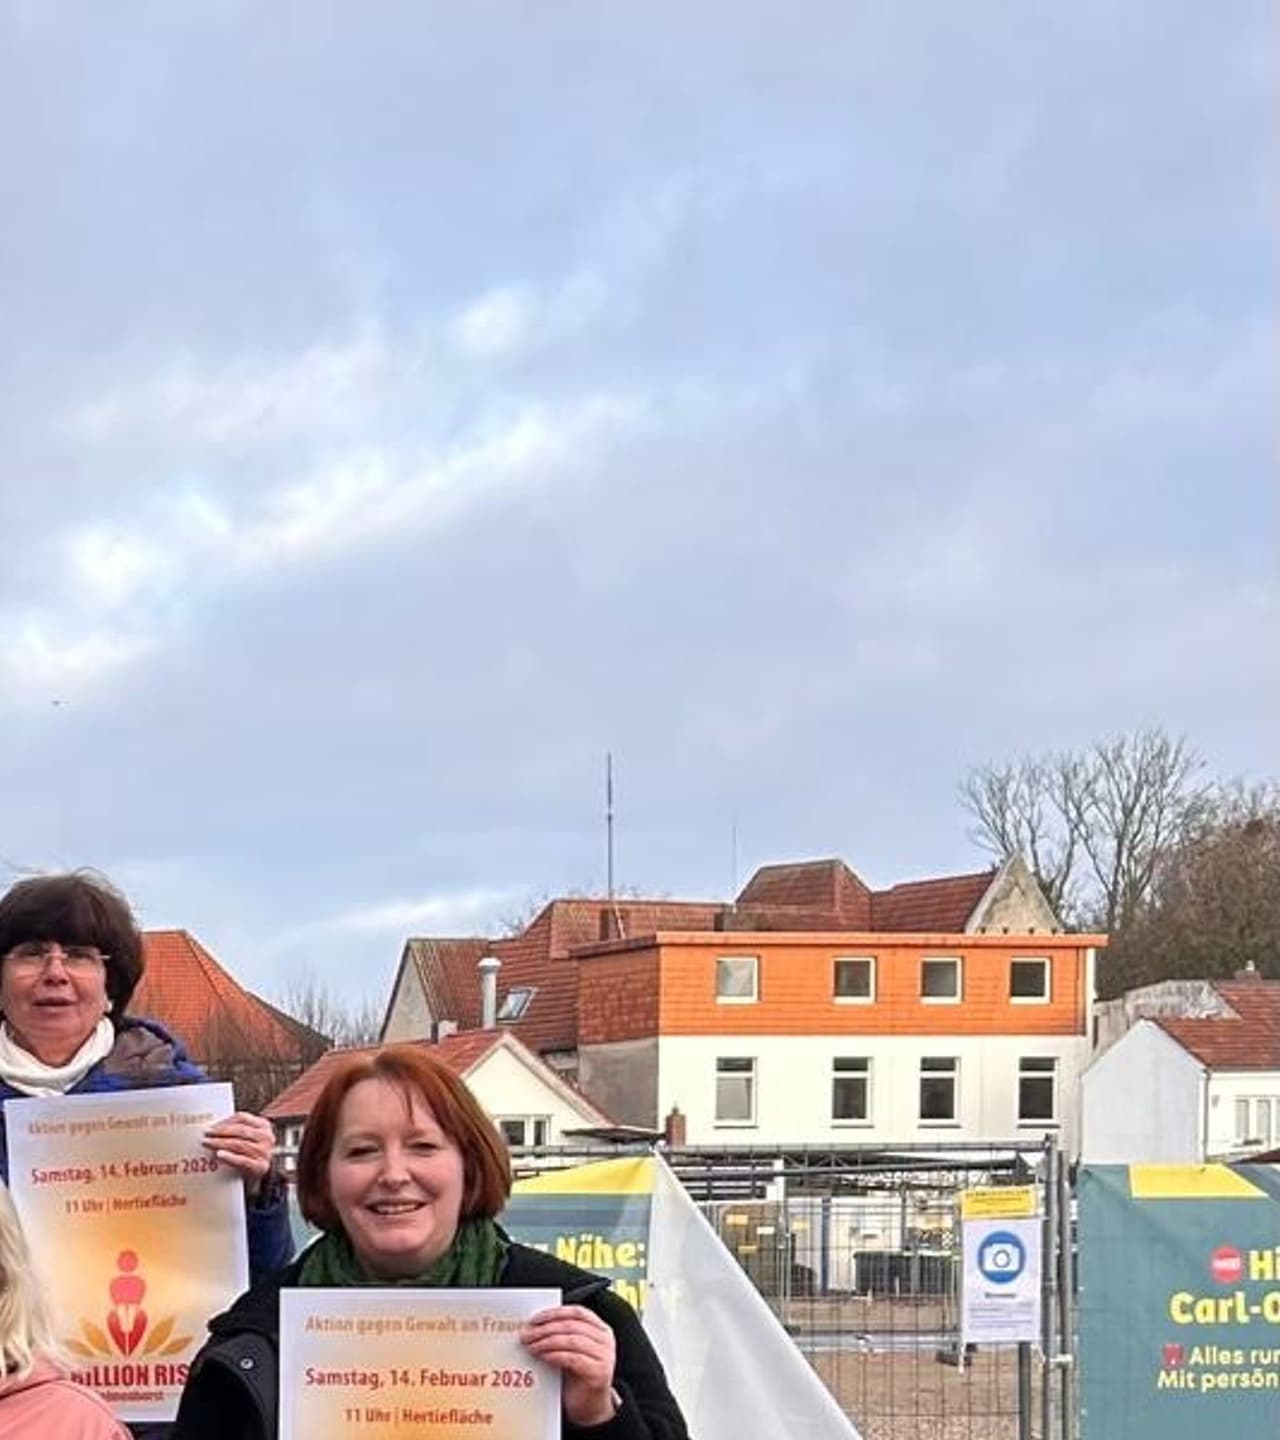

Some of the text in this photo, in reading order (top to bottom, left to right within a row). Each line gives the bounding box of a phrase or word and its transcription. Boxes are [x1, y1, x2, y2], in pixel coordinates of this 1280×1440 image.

[100, 1164, 121, 1180] 14.
[125, 1161, 178, 1178] Februar
[183, 1158, 218, 1173] 2026
[556, 1232, 646, 1269] Nähe:
[305, 1316, 354, 1332] Aktion
[357, 1319, 402, 1335] gegen
[405, 1317, 458, 1332] Gewalt
[460, 1320, 478, 1332] an
[1190, 1344, 1243, 1365] Alles
[154, 1363, 190, 1386] RIS
[305, 1368, 533, 1390] Samstag, 14. Februar 2026
[1158, 1369, 1196, 1389] Mit
[345, 1407, 493, 1425] 11 Uhr Hertiefläche
